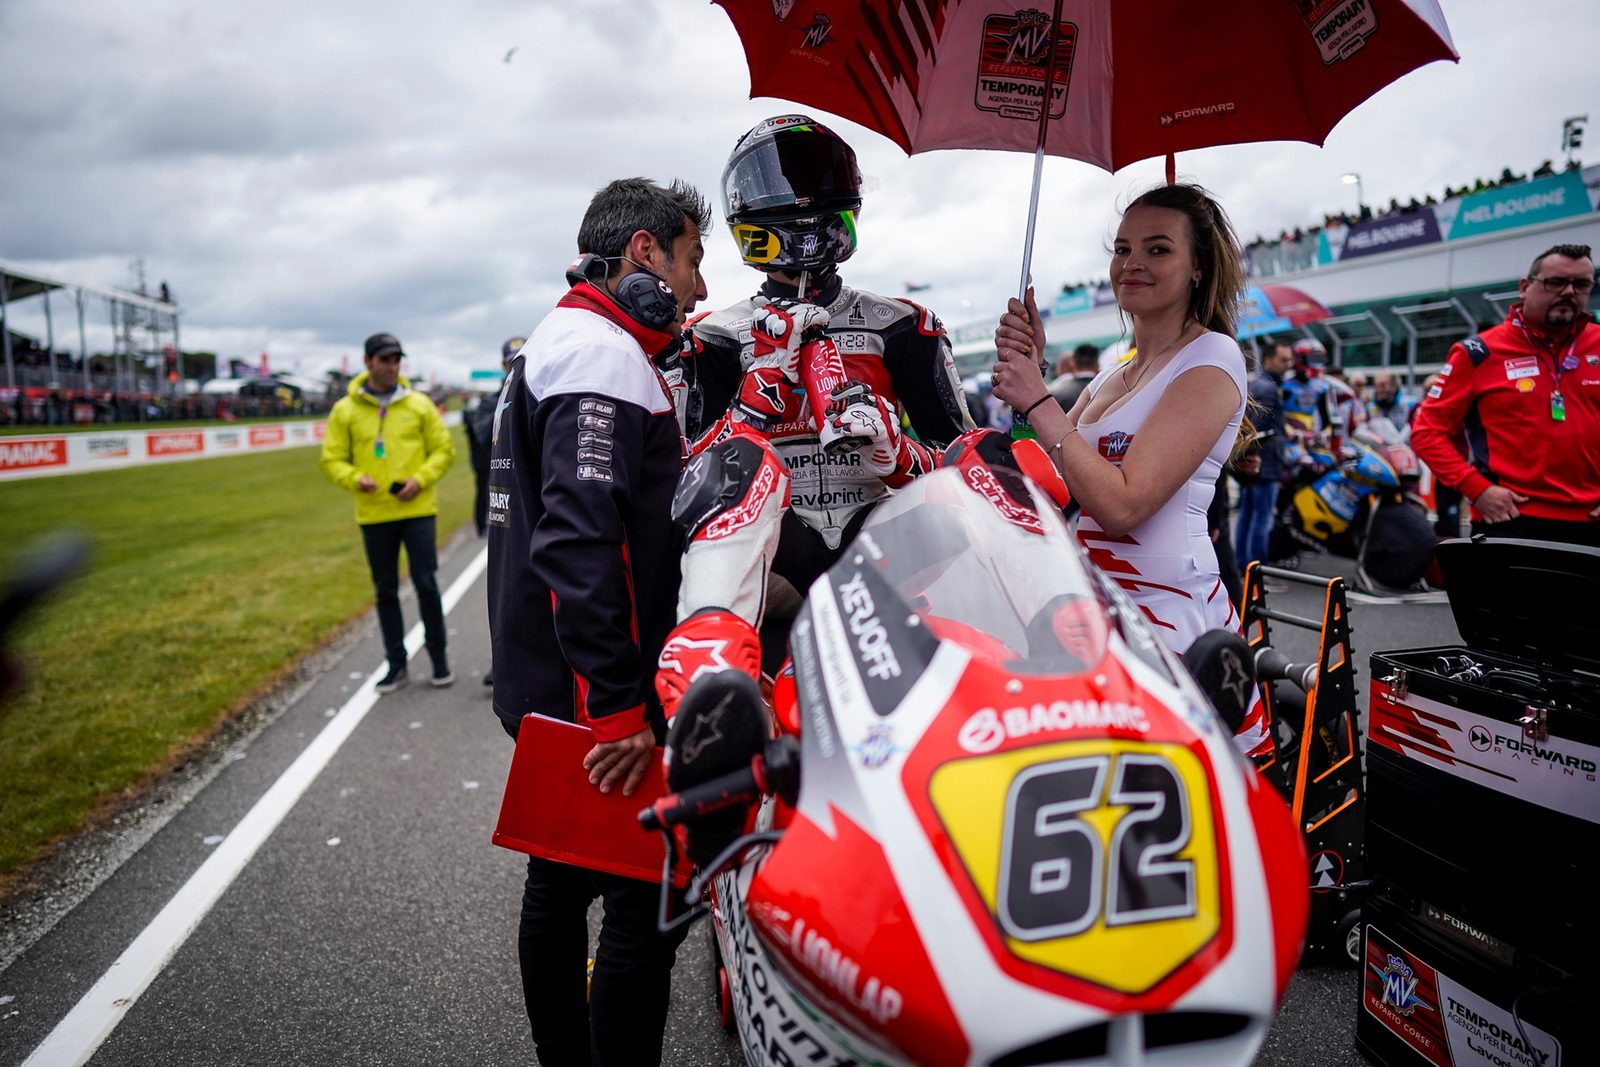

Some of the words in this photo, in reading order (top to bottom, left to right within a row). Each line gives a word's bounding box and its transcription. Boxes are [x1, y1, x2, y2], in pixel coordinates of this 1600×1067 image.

[801, 25, 833, 49] MV
[1004, 23, 1052, 64] MV
[1030, 69, 1060, 79] COE
[1174, 102, 1235, 120] FORWARD
[1462, 186, 1566, 225] MELBOURNE
[1349, 217, 1426, 250] MELBOURNE
[1107, 435, 1127, 456] MV
[839, 571, 902, 680] XERJOFF
[1003, 699, 1150, 739] BAOMARC
[1495, 735, 1596, 772] FORWARD
[999, 752, 1197, 942] 62
[1381, 974, 1419, 1006] MV
[1371, 997, 1401, 1025] REPARTO
[1403, 1023, 1431, 1048] CORSE
[1447, 1011, 1482, 1040] AGENZIA
[1483, 1032, 1499, 1049] PER
